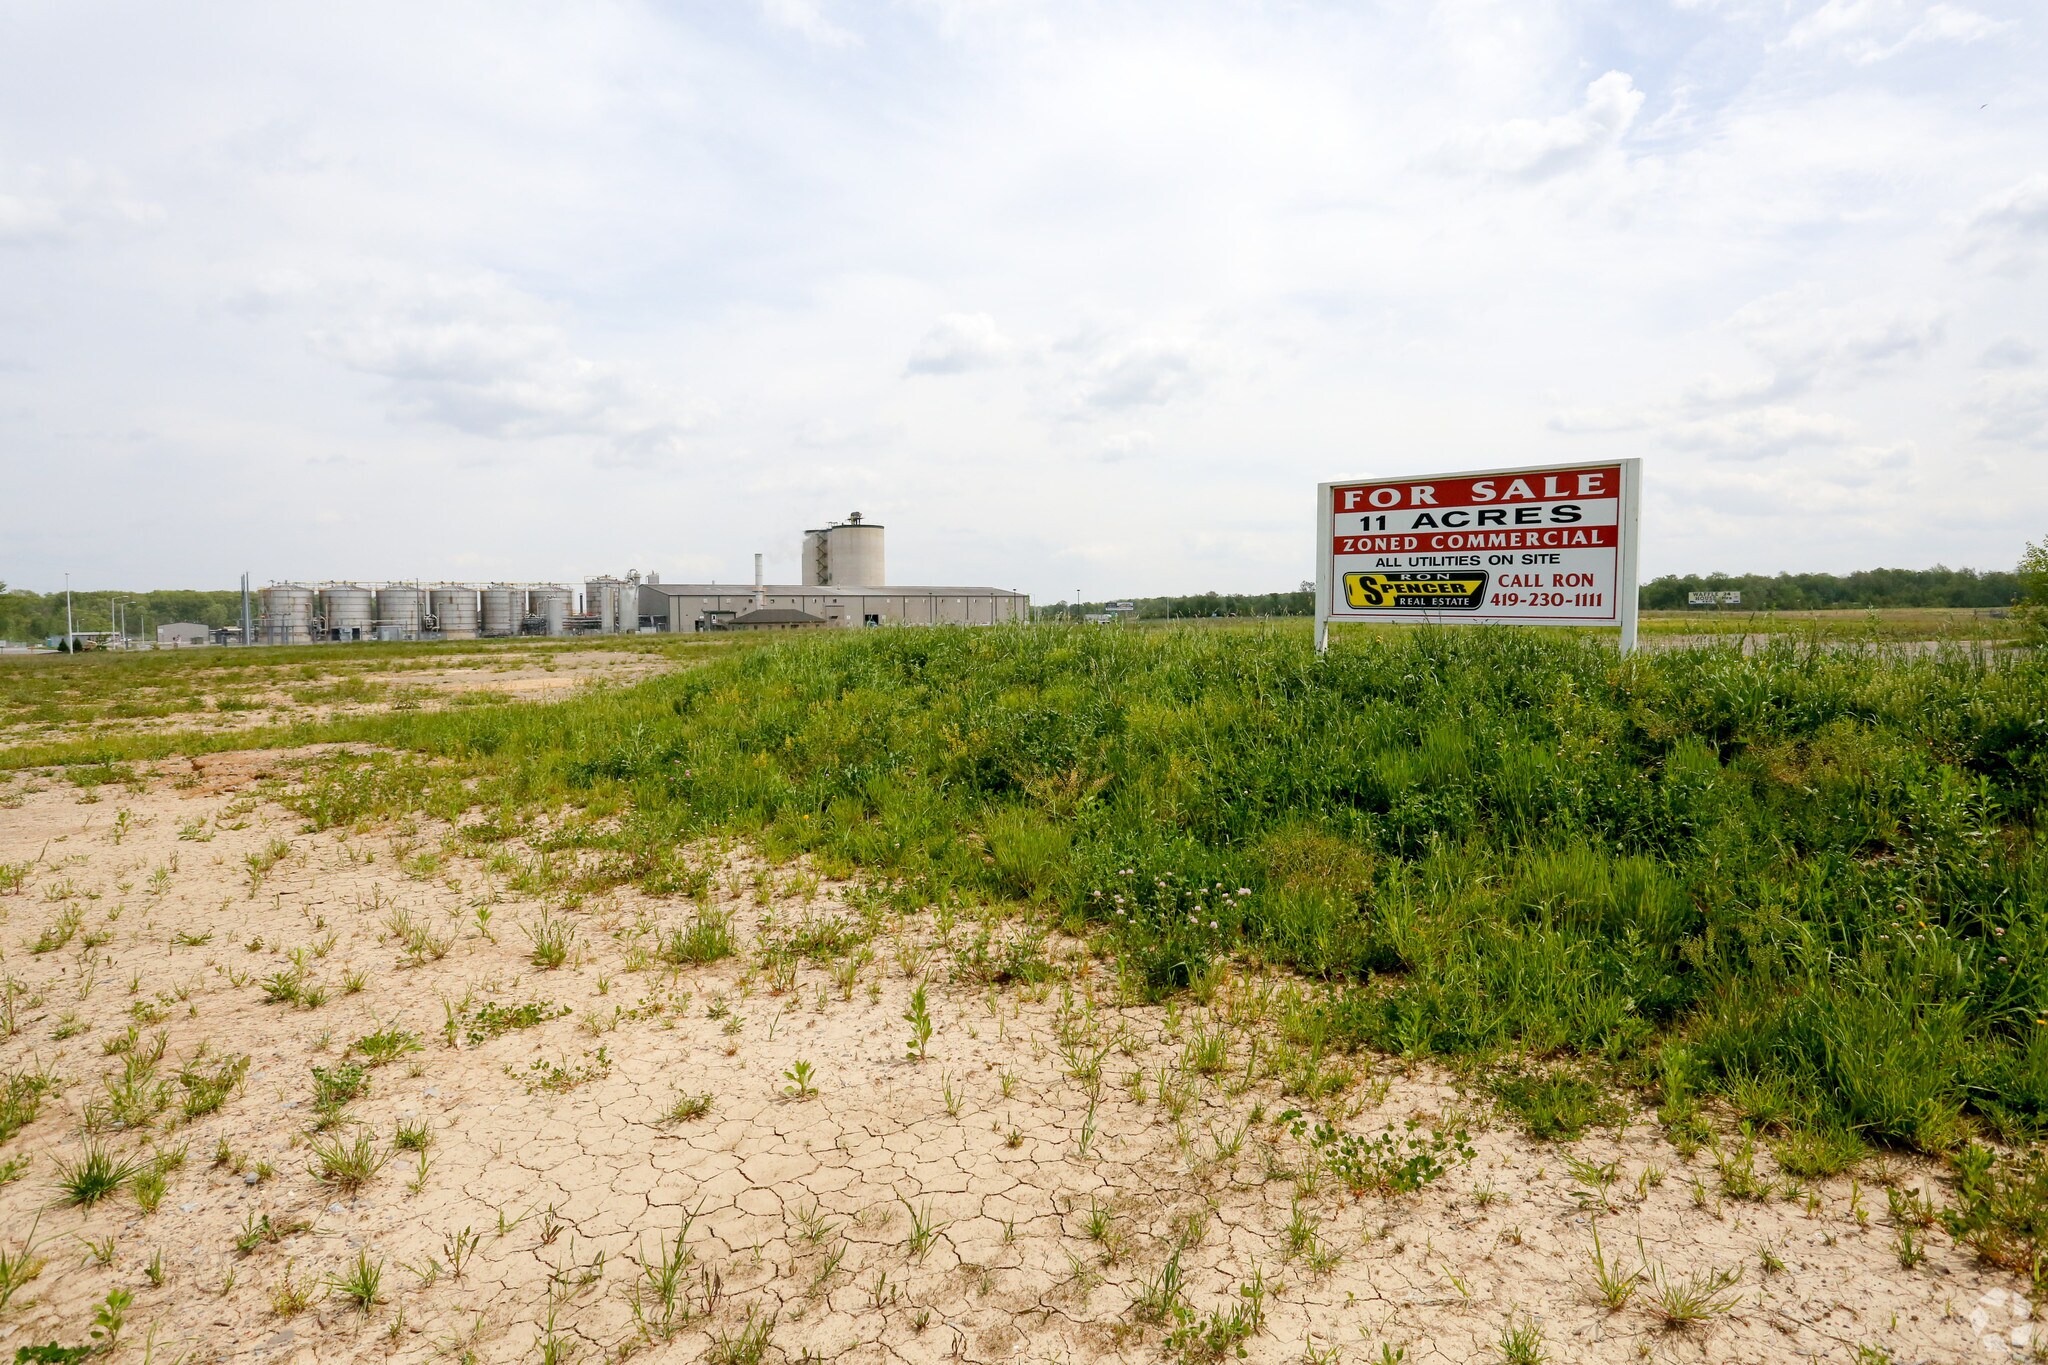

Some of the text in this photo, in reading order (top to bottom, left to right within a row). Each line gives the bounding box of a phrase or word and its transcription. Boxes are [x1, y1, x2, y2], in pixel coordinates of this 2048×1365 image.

[1344, 473, 1606, 509] FOR SALE
[1360, 505, 1582, 531] 11 ACRES
[1343, 530, 1604, 552] ZONED COMMERCIAL
[1376, 553, 1560, 568] ALL UTILITIES ON SITE
[1498, 573, 1594, 587] CALL RON
[1359, 576, 1466, 605] SPENCER
[1491, 592, 1602, 607] 419-230-1111
[1400, 598, 1470, 606] REAL ESTATE
